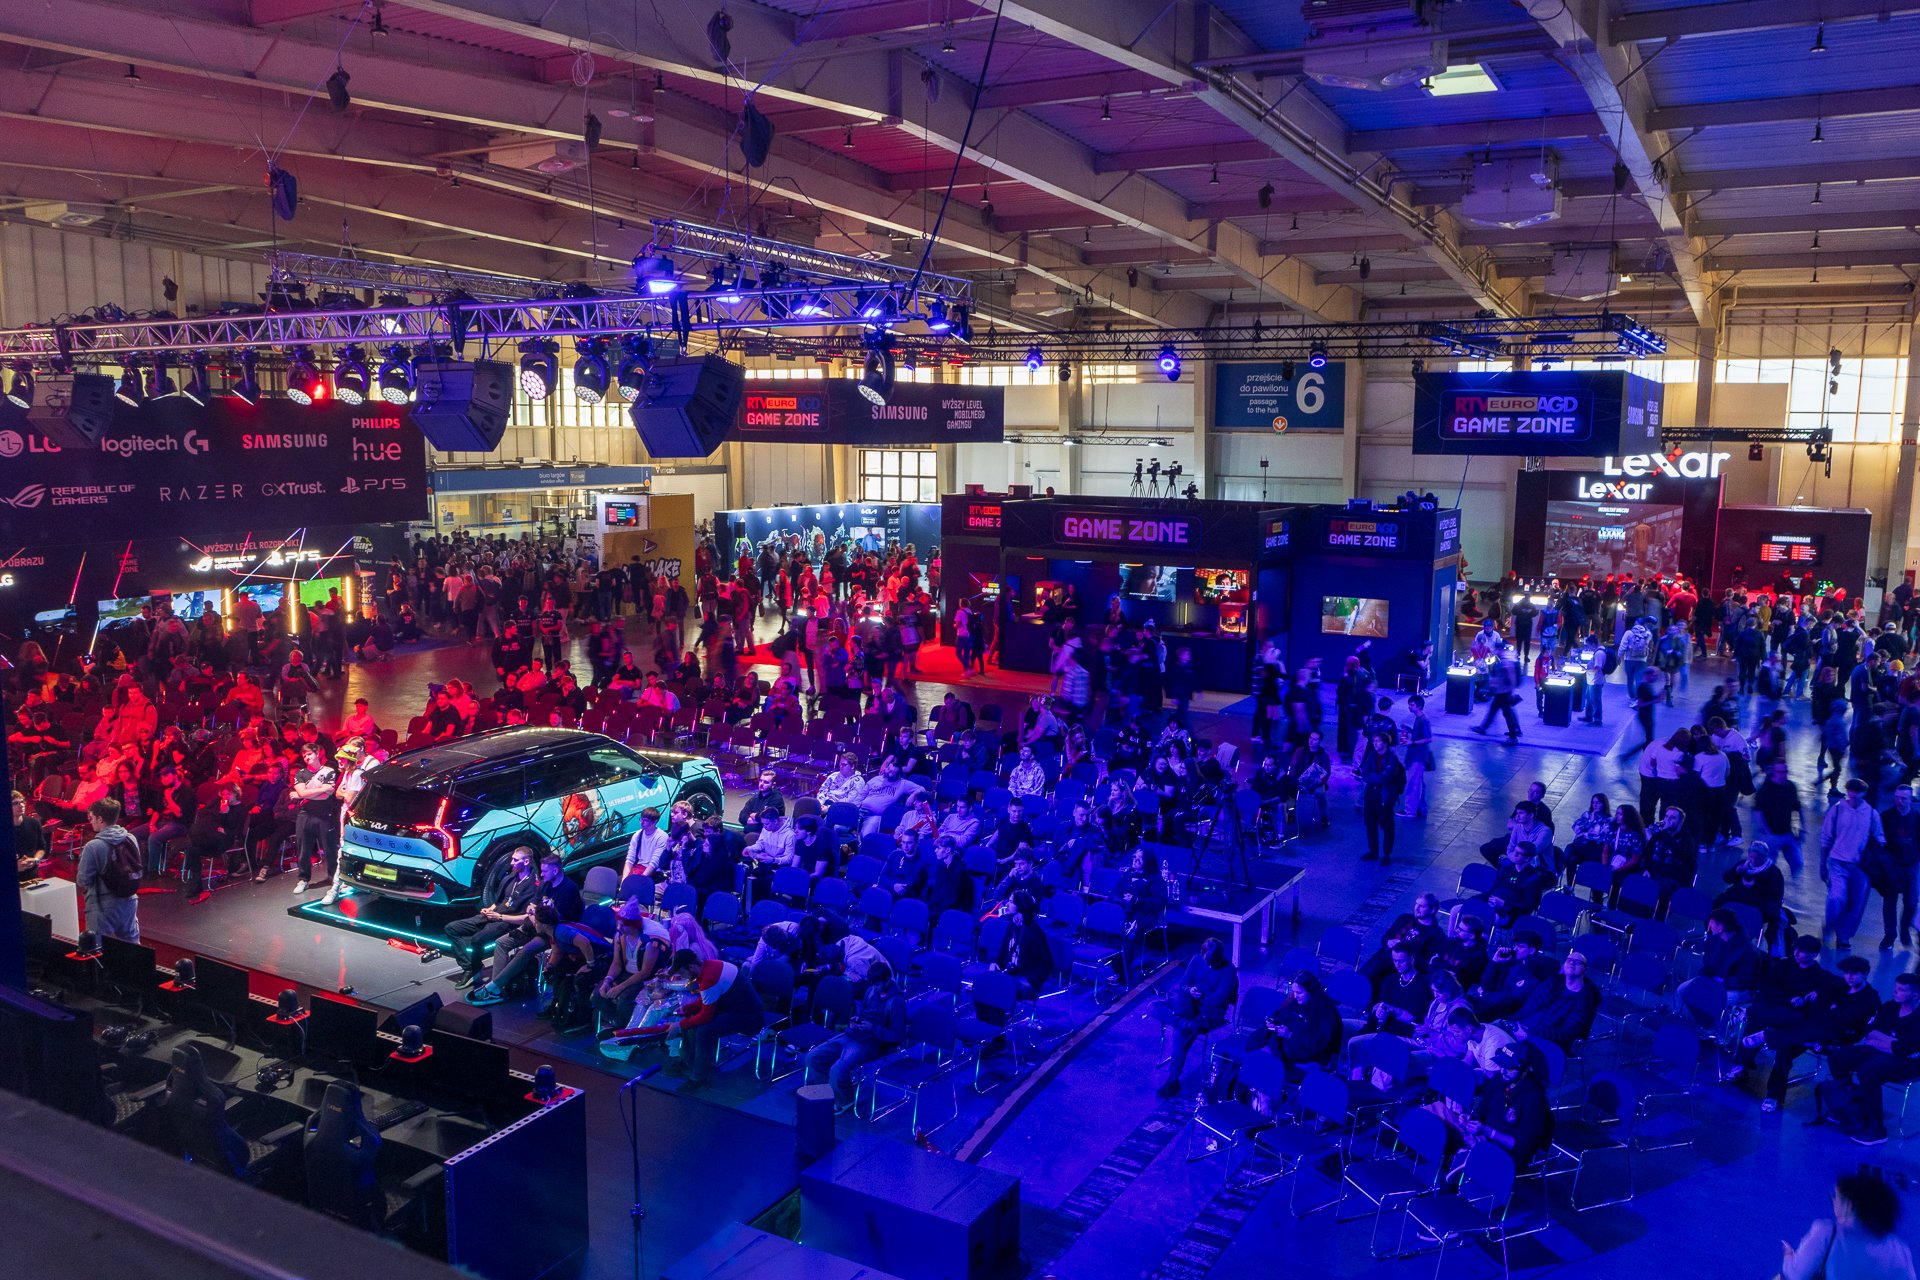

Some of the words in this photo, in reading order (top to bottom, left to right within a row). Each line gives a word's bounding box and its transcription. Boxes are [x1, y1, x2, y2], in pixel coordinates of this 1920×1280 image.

[1247, 373, 1282, 383] przejście
[1240, 384, 1250, 392] do
[1253, 384, 1288, 393] pawilonu
[1296, 372, 1325, 414] 6
[942, 398, 965, 409] WYŻSZY
[966, 400, 983, 409] LEVEL
[747, 412, 781, 425] GAME
[784, 413, 819, 426] ZONE
[871, 405, 928, 420] SAMSUNG
[954, 410, 985, 419] MOBILNEGO
[351, 417, 400, 429] PHILIPS
[947, 420, 971, 429] GAMINGU
[1454, 417, 1510, 433] GAME
[1517, 417, 1576, 433] ZONE
[101, 434, 178, 457] logitech
[242, 433, 328, 449] SAMSUNG
[353, 437, 402, 461] hue
[1604, 448, 1732, 478] Lexar
[51, 485, 116, 497] REPUBLIC
[119, 484, 136, 493] OF
[364, 478, 407, 490] PS5
[1578, 476, 1654, 500] Lexar
[159, 484, 244, 501] RAZER
[52, 495, 108, 506] GAMERS
[969, 517, 993, 527] GAME
[1064, 516, 1122, 540] GAME
[1128, 520, 1188, 543] ZONE
[1329, 534, 1361, 545] GAME
[1364, 535, 1397, 547] ZONE
[204, 542, 233, 553] WYŻSZY
[8, 556, 45, 567] OBRAZU
